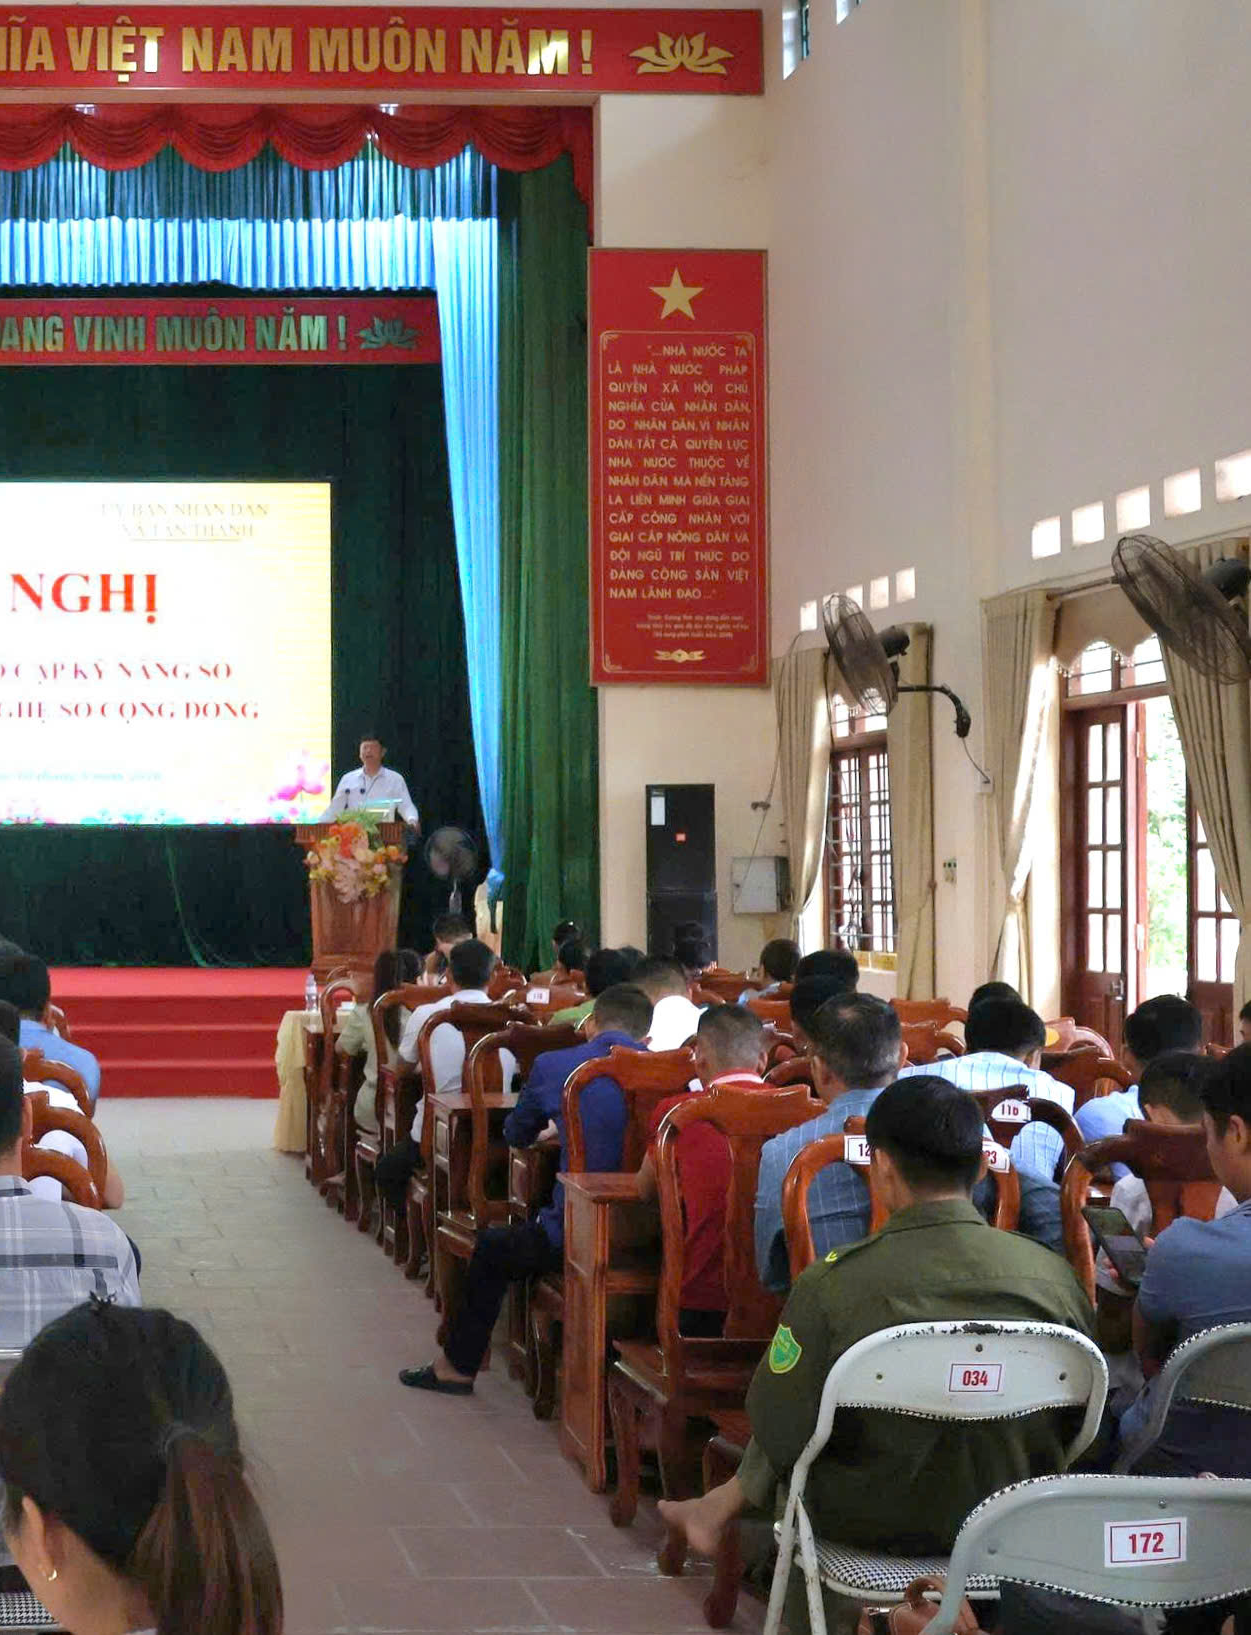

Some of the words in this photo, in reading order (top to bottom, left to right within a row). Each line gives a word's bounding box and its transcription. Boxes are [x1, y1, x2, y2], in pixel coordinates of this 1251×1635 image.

[65, 17, 163, 83] VIỆT
[181, 27, 293, 73] NAM
[308, 18, 447, 73] MUÔN
[461, 18, 570, 75] NĂM
[73, 316, 147, 352] VINH
[156, 307, 246, 352] MUÔN
[255, 306, 328, 352] NĂM
[735, 347, 747, 355] TA
[609, 420, 625, 430] DO
[732, 552, 749, 561] DO
[10, 573, 158, 624] NGHỊ
[610, 588, 637, 598] NAM
[962, 1369, 988, 1386] 034
[1128, 1531, 1164, 1554] 172
